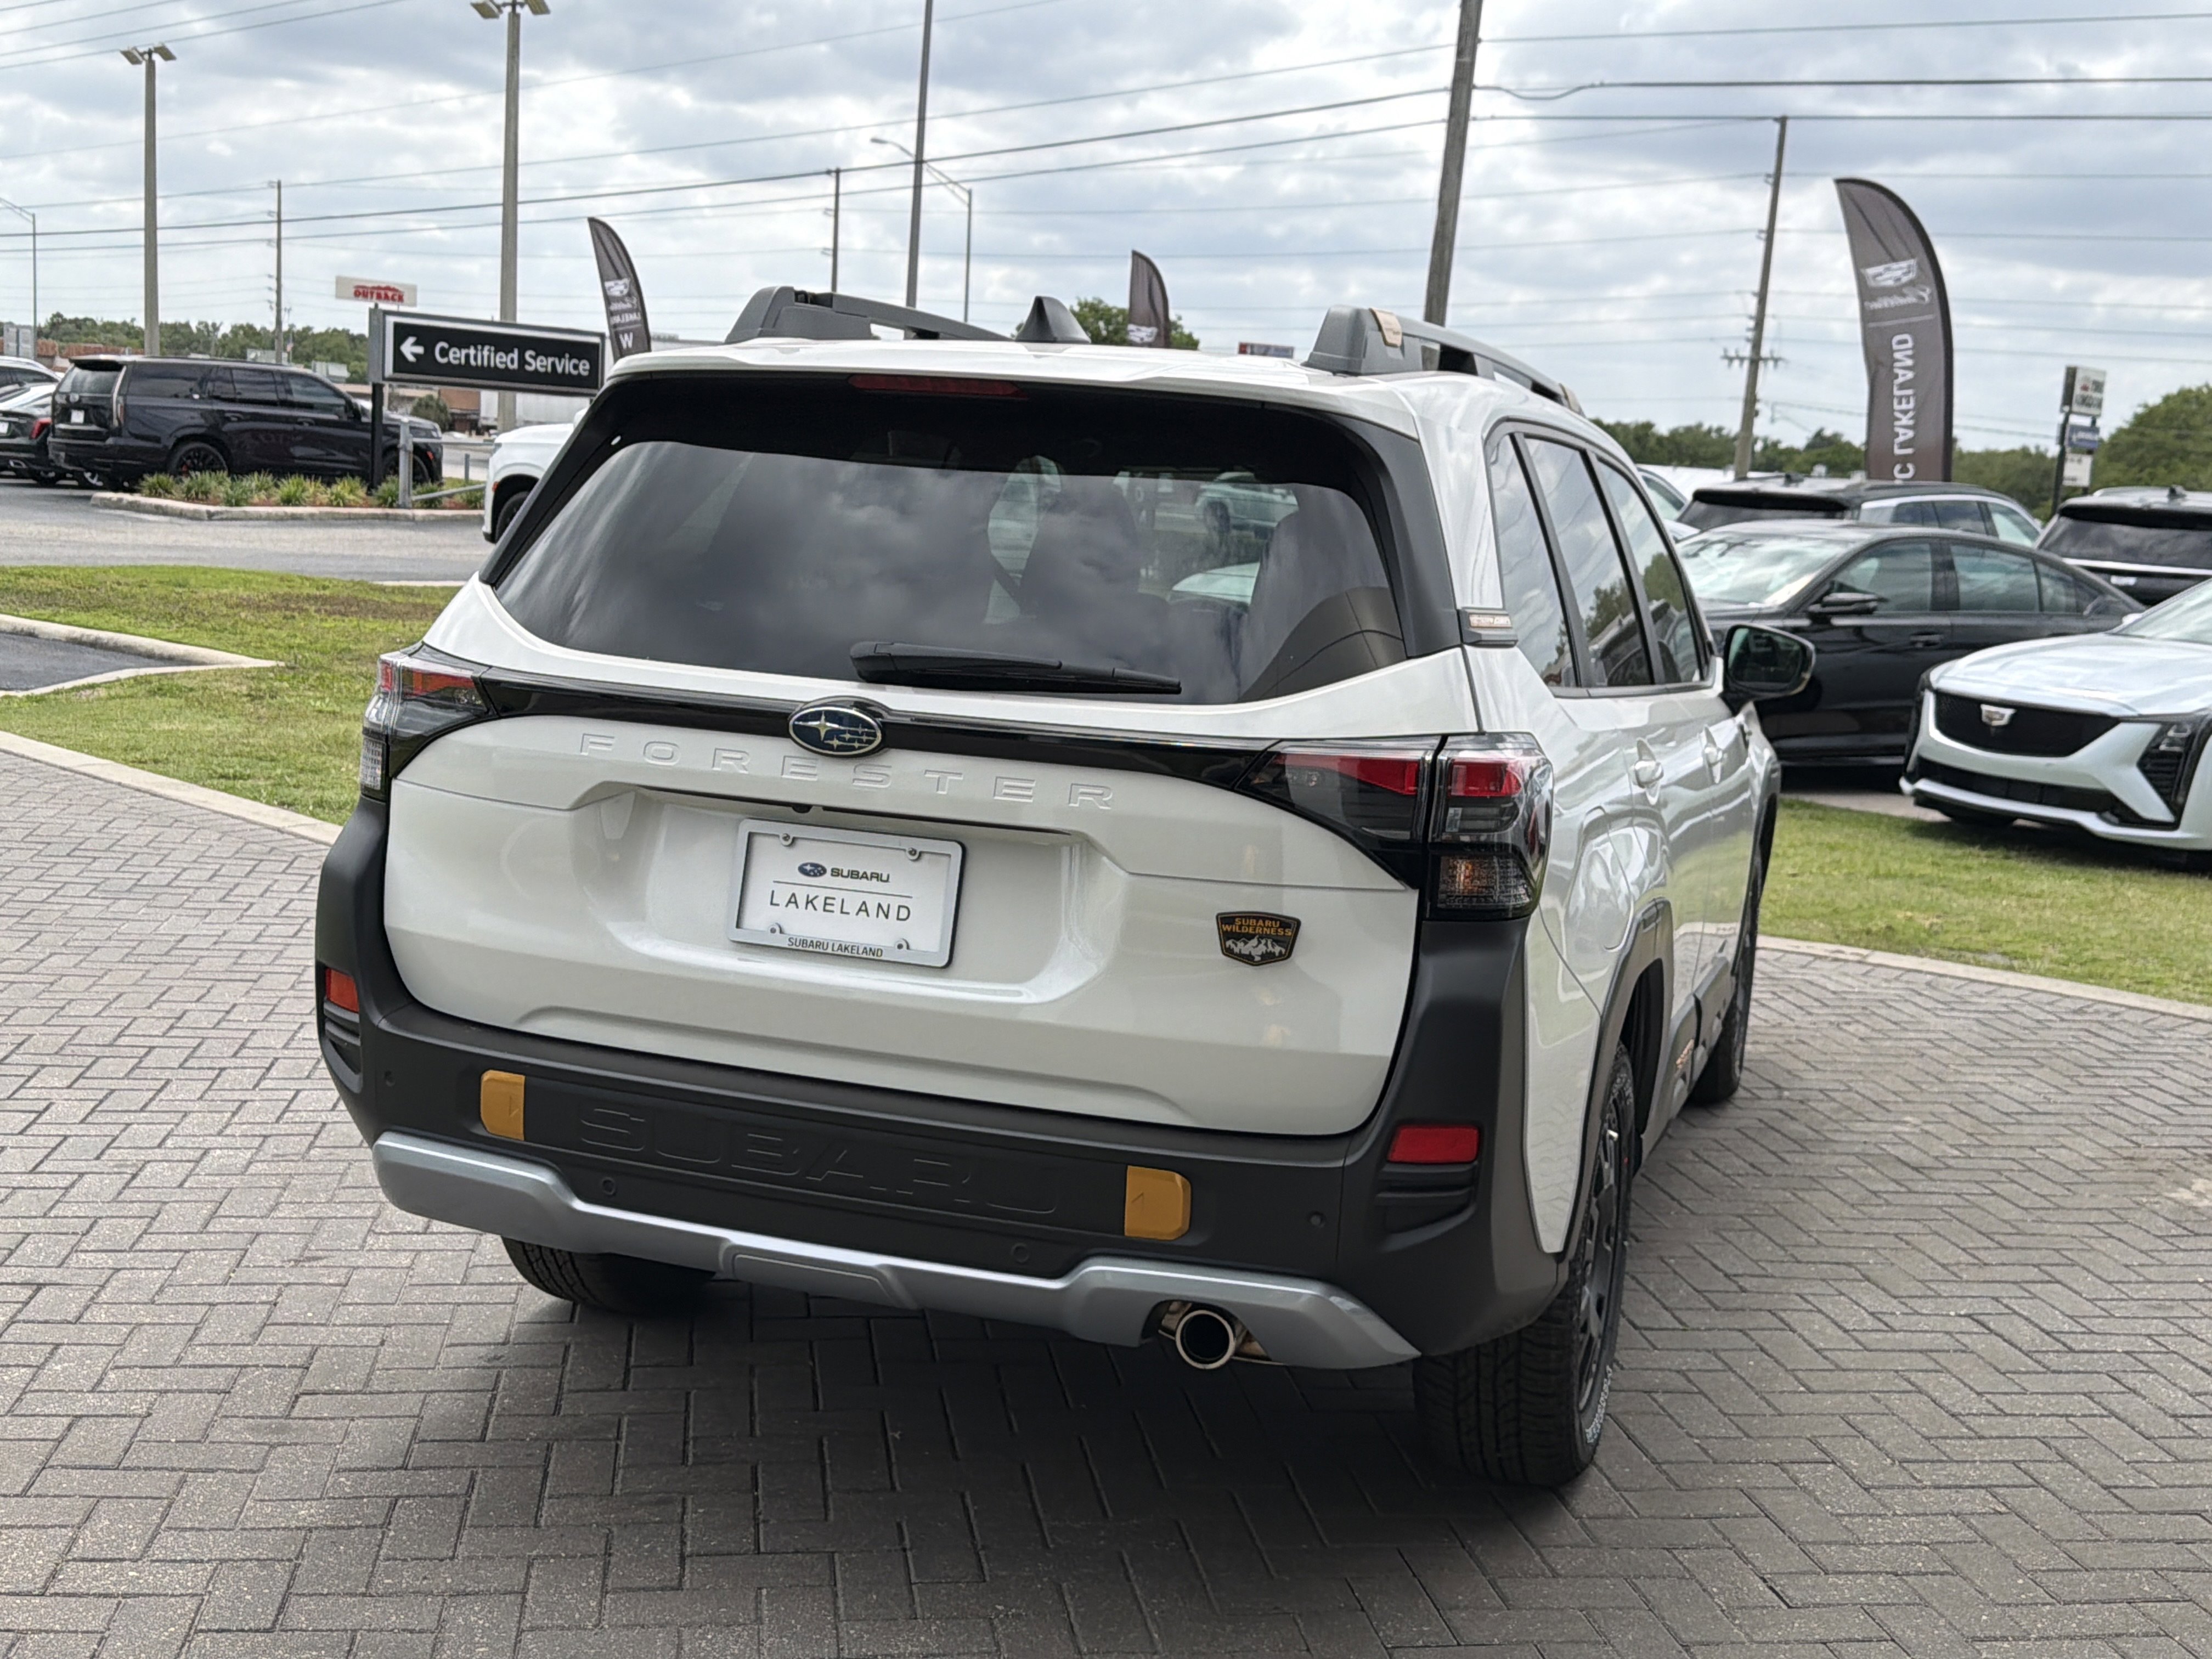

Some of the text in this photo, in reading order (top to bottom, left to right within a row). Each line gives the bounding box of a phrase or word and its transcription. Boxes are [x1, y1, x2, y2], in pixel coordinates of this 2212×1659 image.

[353, 289, 404, 303] OUTBACK
[434, 340, 591, 377] Certified Service
[579, 732, 1113, 810] FORESTER
[830, 867, 890, 883] SUBARU
[769, 889, 911, 922] LAKELAND
[1222, 924, 1292, 936] WILDERNESS
[1234, 917, 1280, 928] SUBARU
[787, 937, 883, 958] SUBARU LAKELAND
